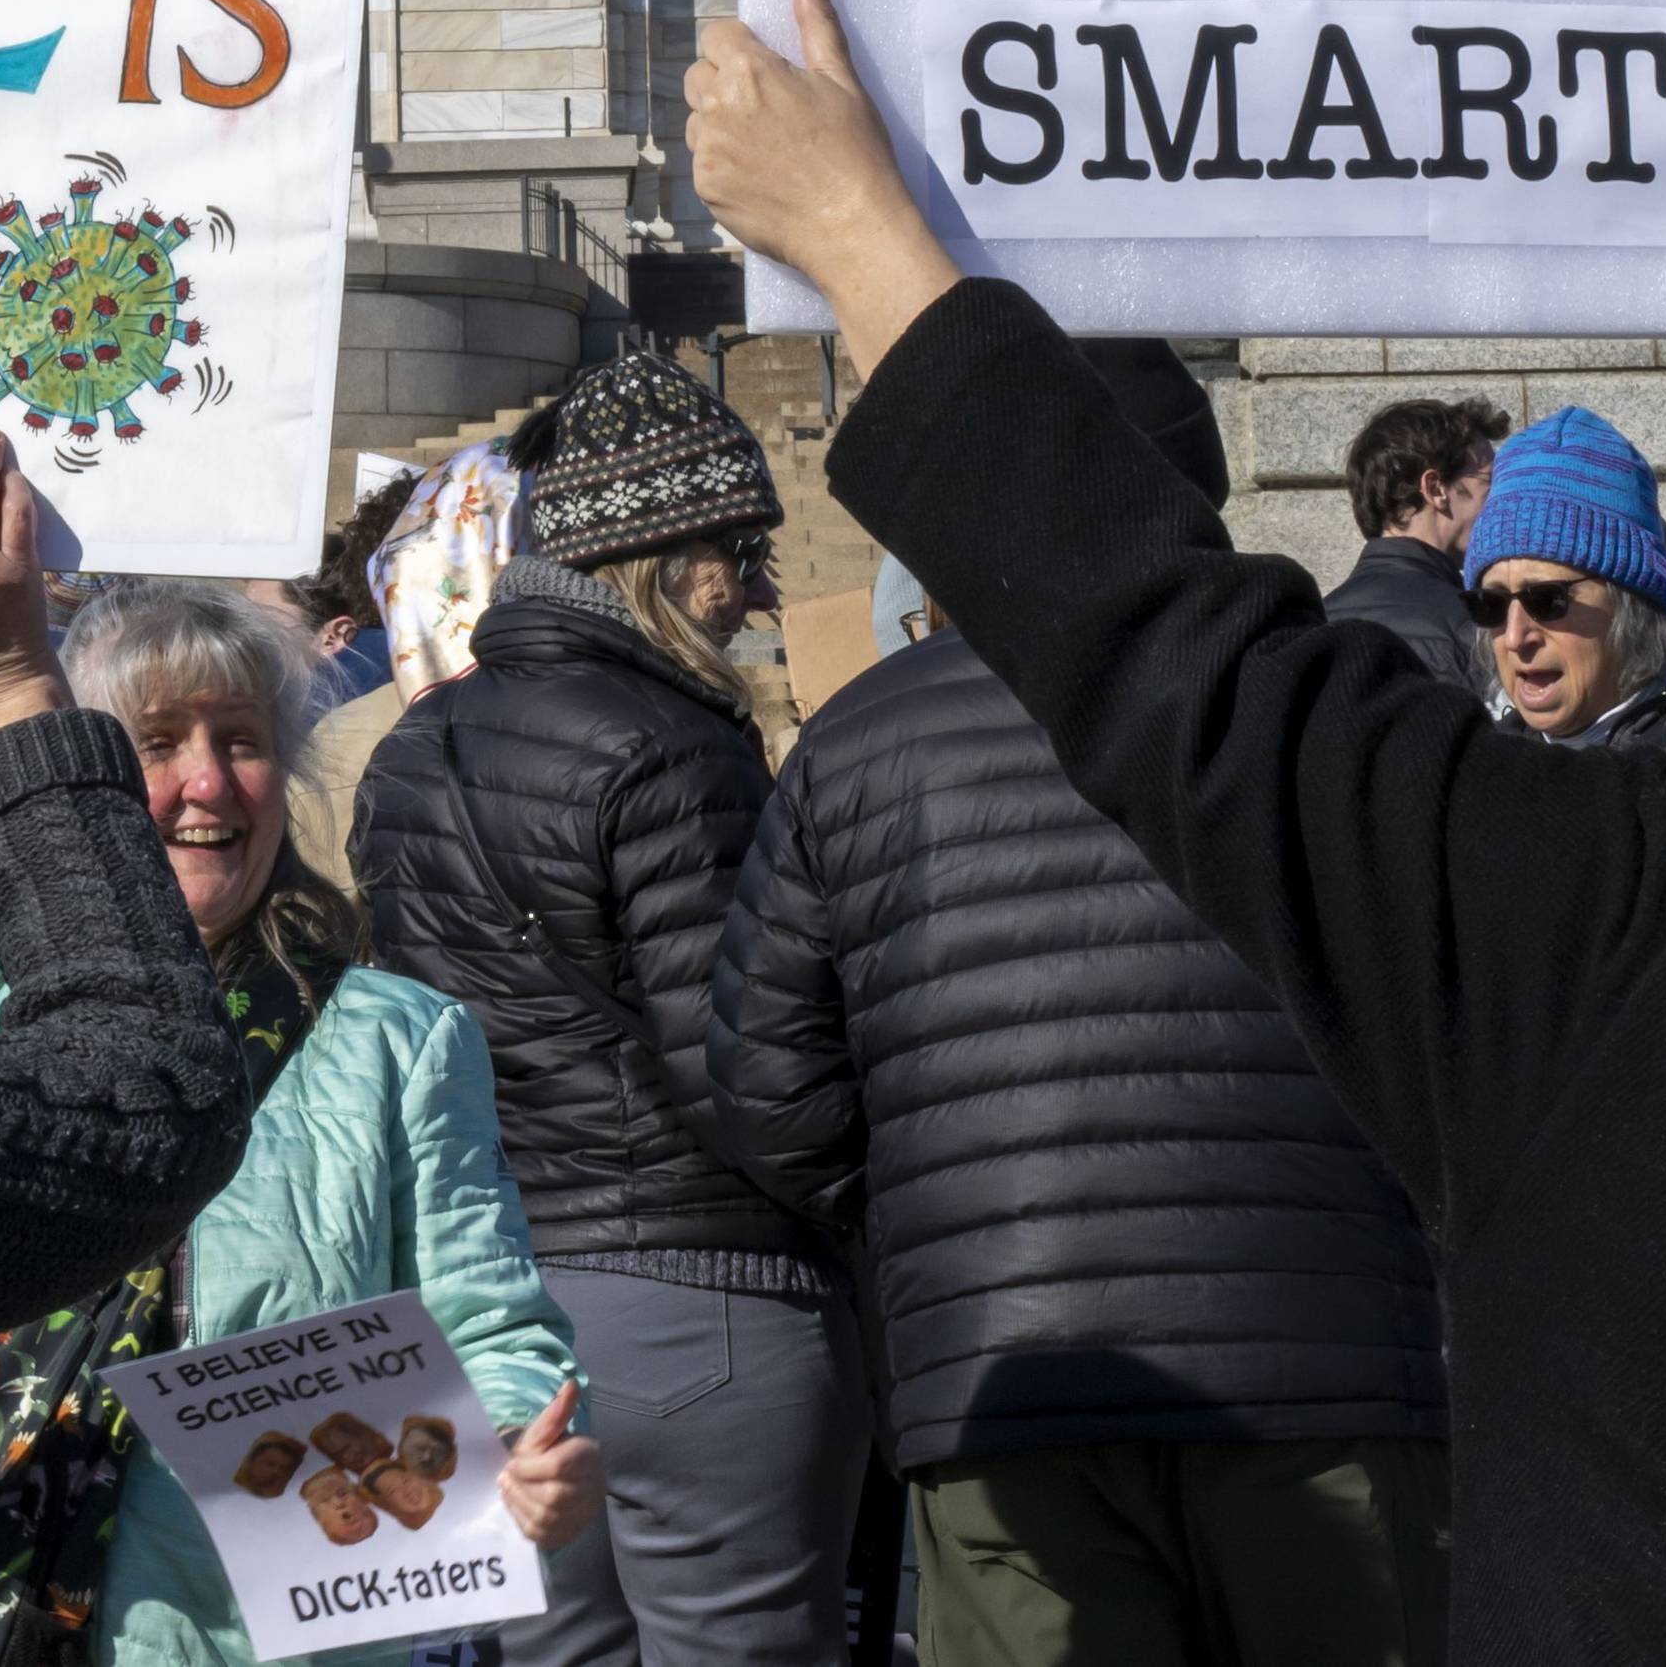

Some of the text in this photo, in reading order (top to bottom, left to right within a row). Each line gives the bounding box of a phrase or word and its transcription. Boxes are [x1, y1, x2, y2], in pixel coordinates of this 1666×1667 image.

[146, 1311, 393, 1397] I BELIEVE IN
[176, 1342, 429, 1431] SCIENCE NOT
[288, 1554, 508, 1623] DICK-taters
